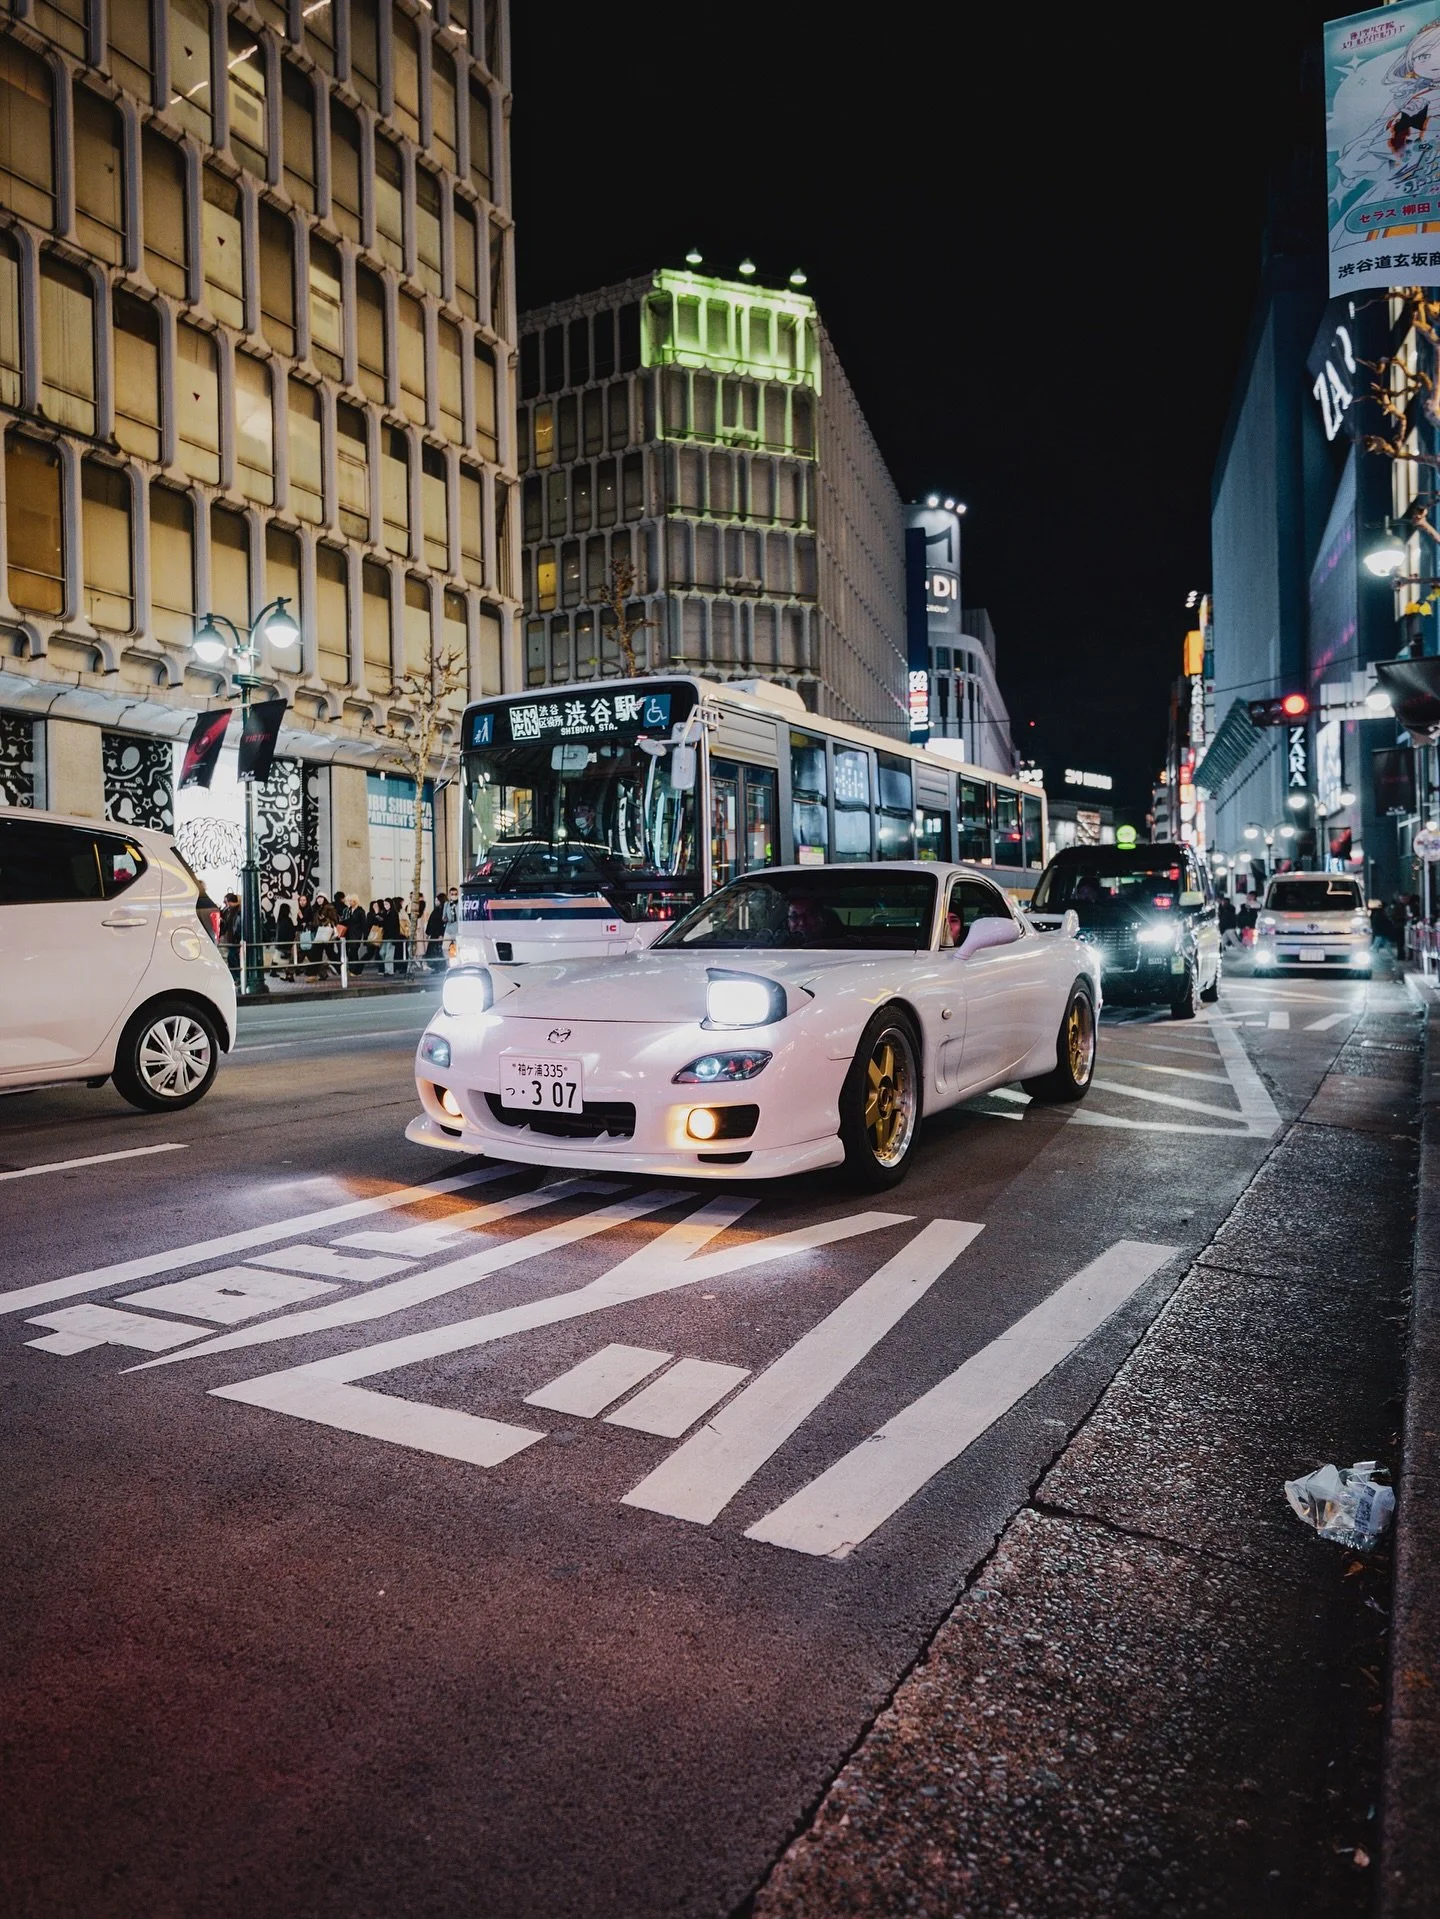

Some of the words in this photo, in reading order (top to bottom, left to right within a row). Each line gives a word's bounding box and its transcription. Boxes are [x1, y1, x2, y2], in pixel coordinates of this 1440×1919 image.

[1360, 208, 1396, 224] セラス
[1402, 202, 1431, 216] 柳田
[925, 575, 957, 600] DI
[539, 704, 559, 717] 渋谷
[565, 695, 638, 727] 渋谷駅
[909, 671, 928, 731] SEIBU
[1191, 674, 1204, 742] KARAOKE
[539, 716, 564, 729] 区役所
[561, 725, 595, 736] SHIBUYA
[599, 722, 618, 732] STA.
[1289, 726, 1307, 787] ZARA
[388, 797, 432, 817] SHIBYA
[409, 816, 433, 830] SRE
